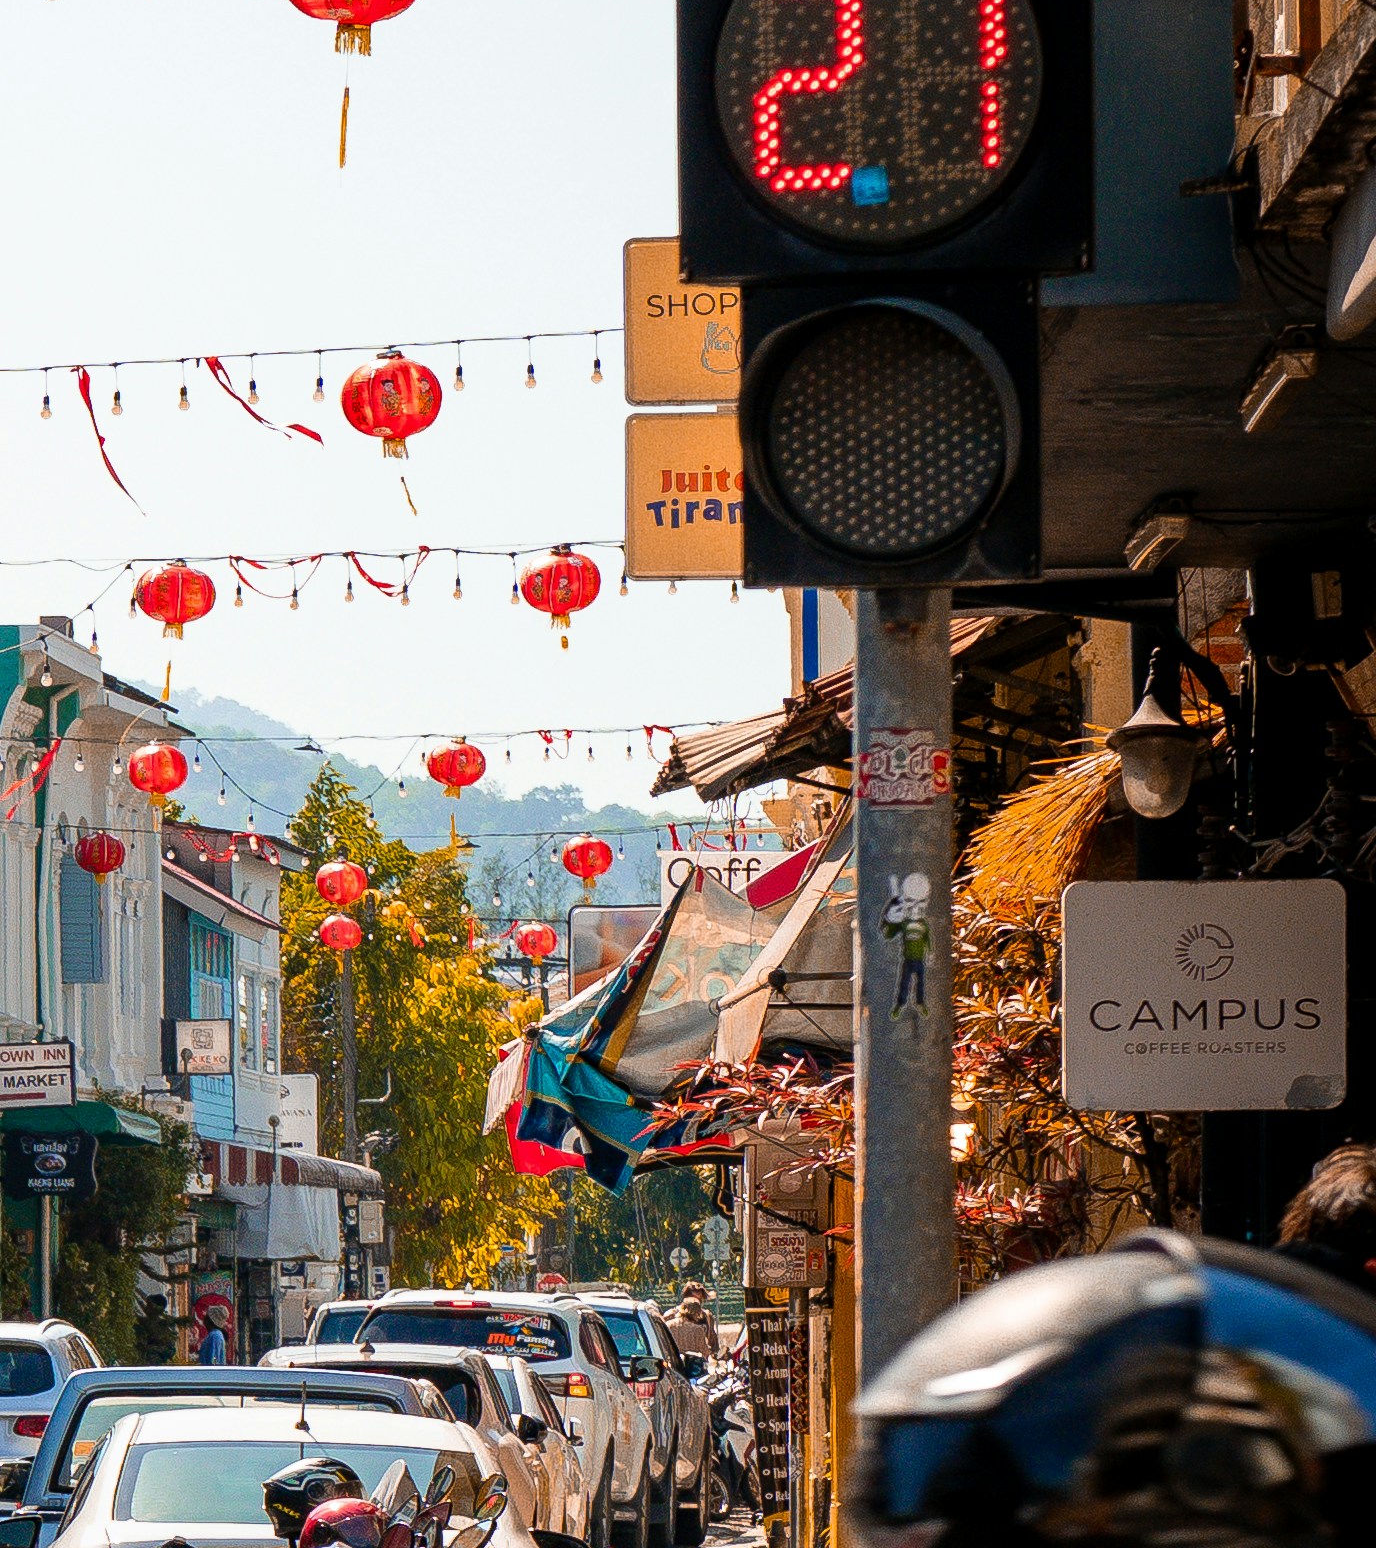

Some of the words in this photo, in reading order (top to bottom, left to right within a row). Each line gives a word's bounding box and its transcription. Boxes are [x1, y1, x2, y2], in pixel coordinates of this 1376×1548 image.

[646, 291, 739, 319] SHOP
[1089, 997, 1322, 1032] CAMPUS
[43, 1047, 67, 1061] INN
[1124, 1042, 1191, 1054] COFFEE
[1198, 1041, 1287, 1054] ROASTERS
[3, 1072, 68, 1089] MARKET
[761, 1318, 783, 1332] Thai
